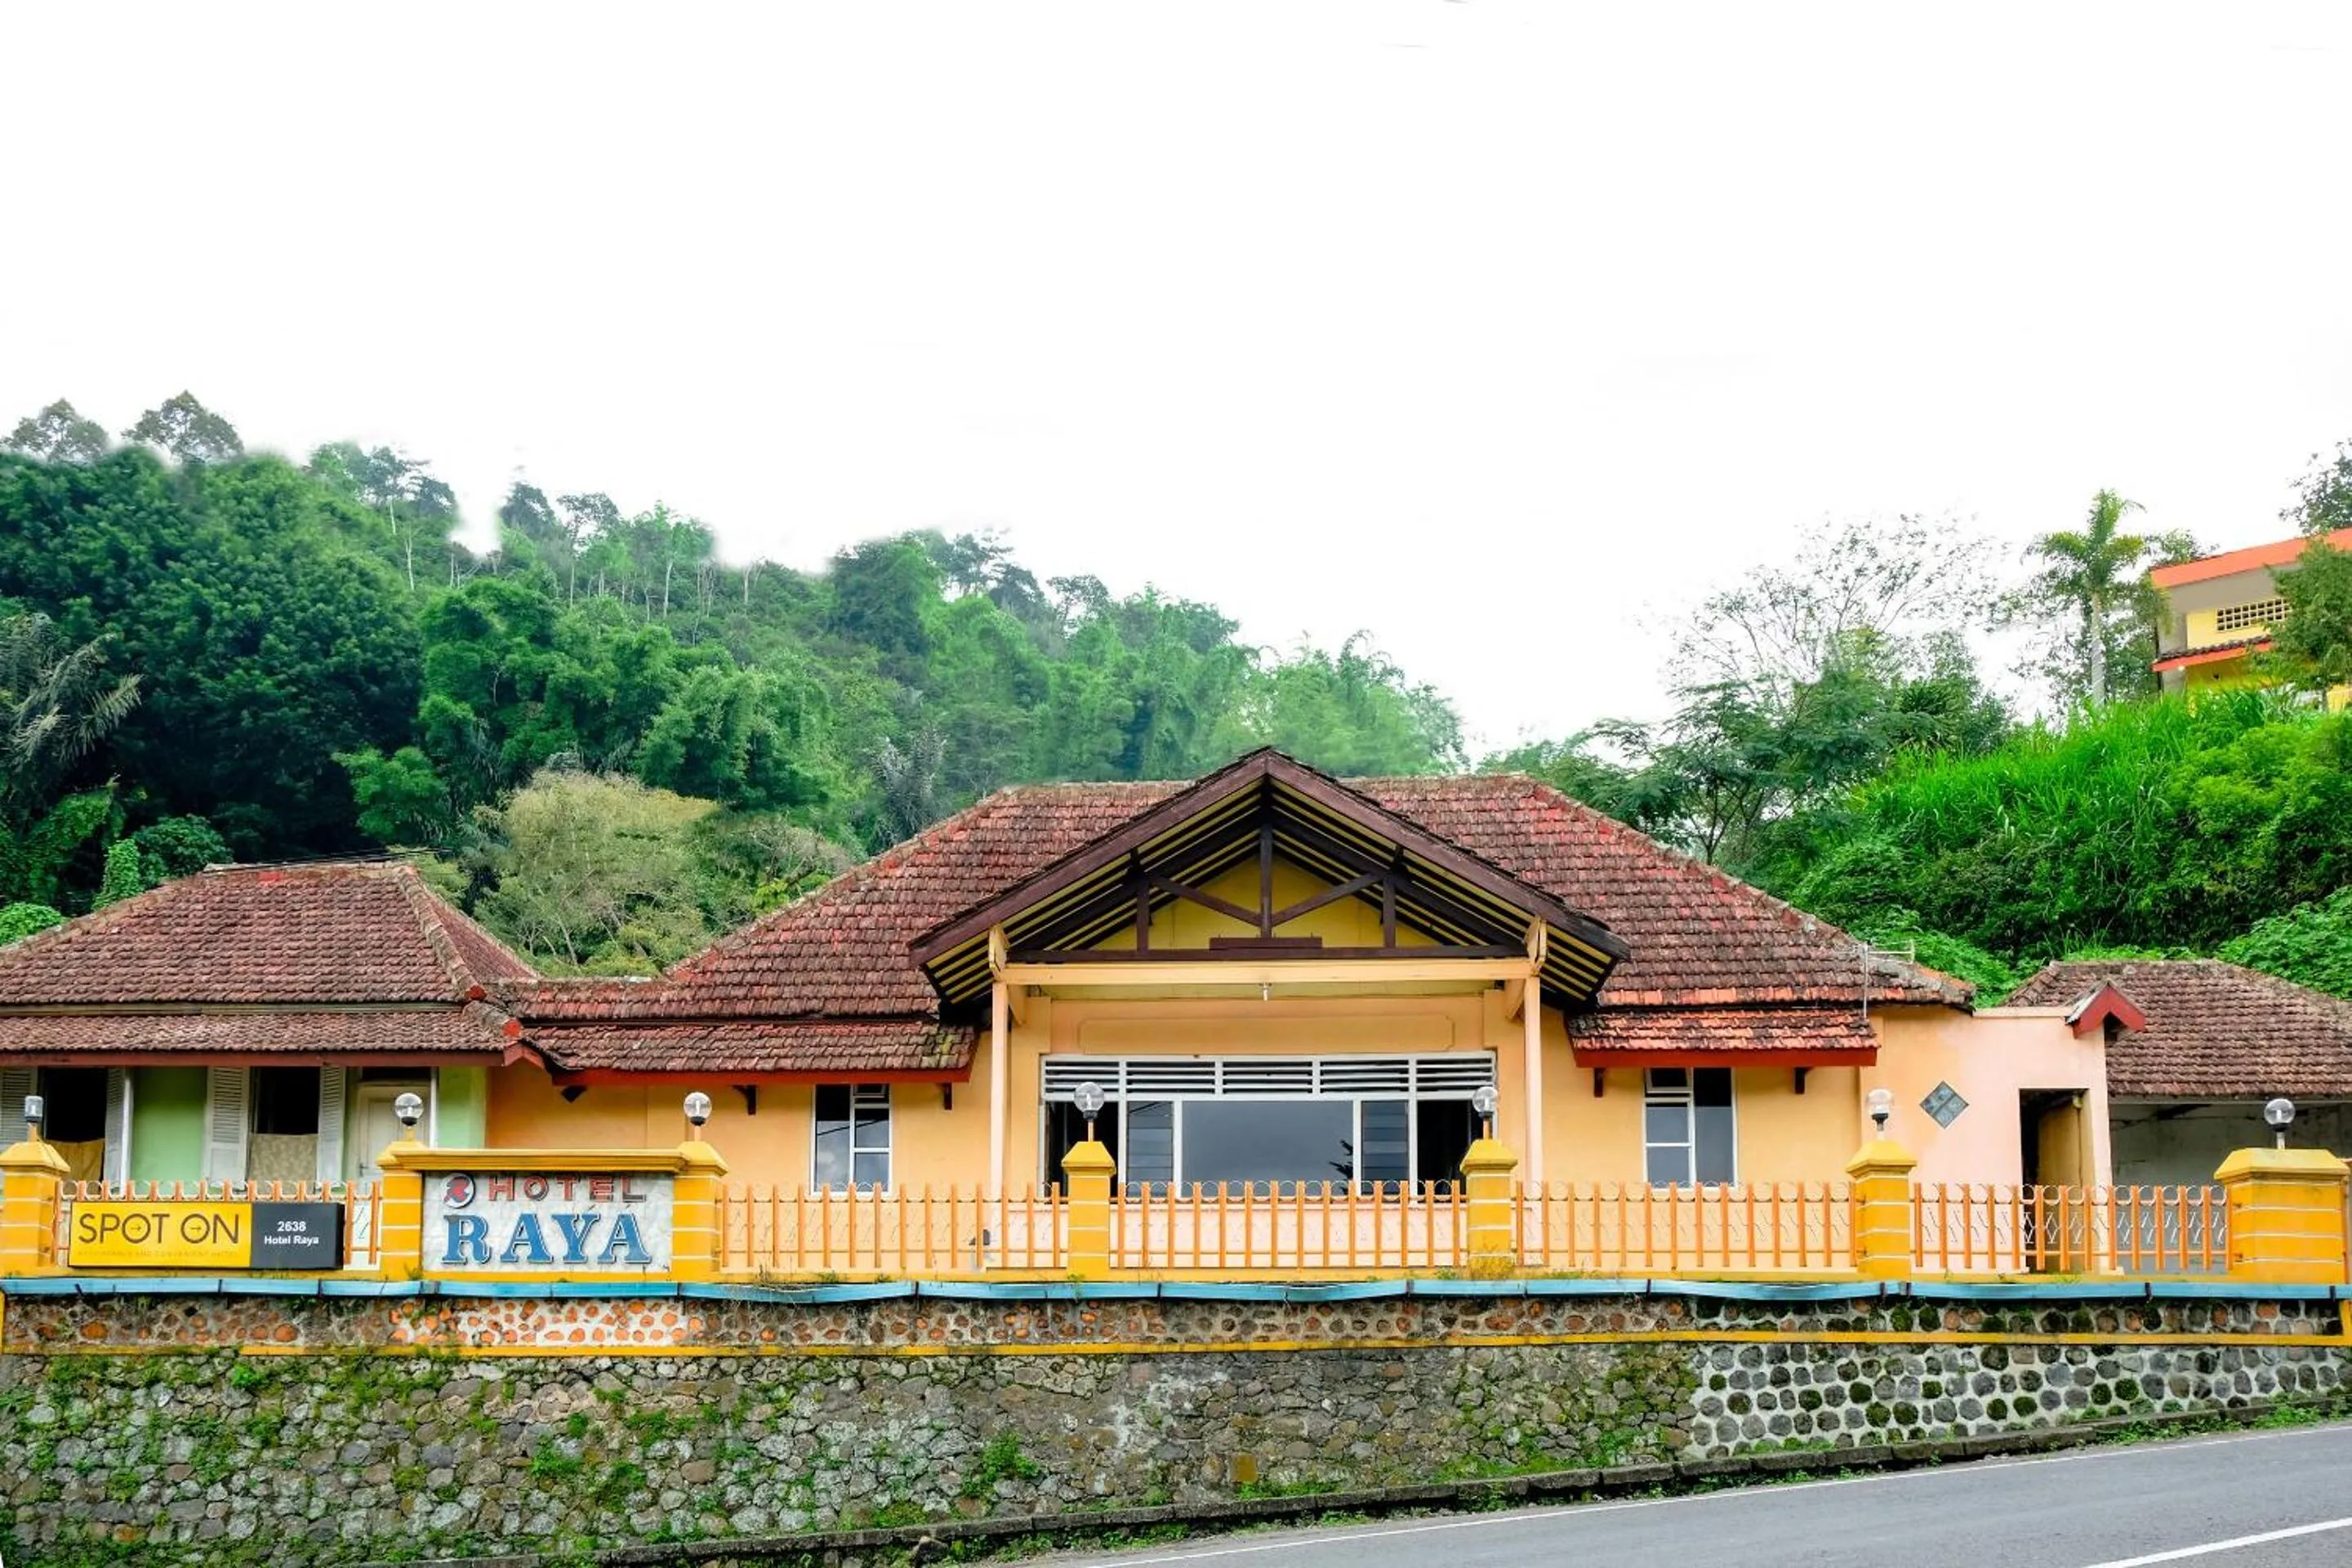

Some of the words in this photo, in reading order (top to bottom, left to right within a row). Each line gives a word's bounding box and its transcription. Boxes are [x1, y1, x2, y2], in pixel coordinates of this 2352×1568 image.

[488, 1176, 647, 1202] HOTEL
[78, 1213, 170, 1245] SPOT
[180, 1213, 239, 1245] ON
[277, 1221, 307, 1232] 2638
[442, 1213, 653, 1264] RAYA
[264, 1235, 291, 1245] Hotel
[293, 1235, 319, 1247] Raya
